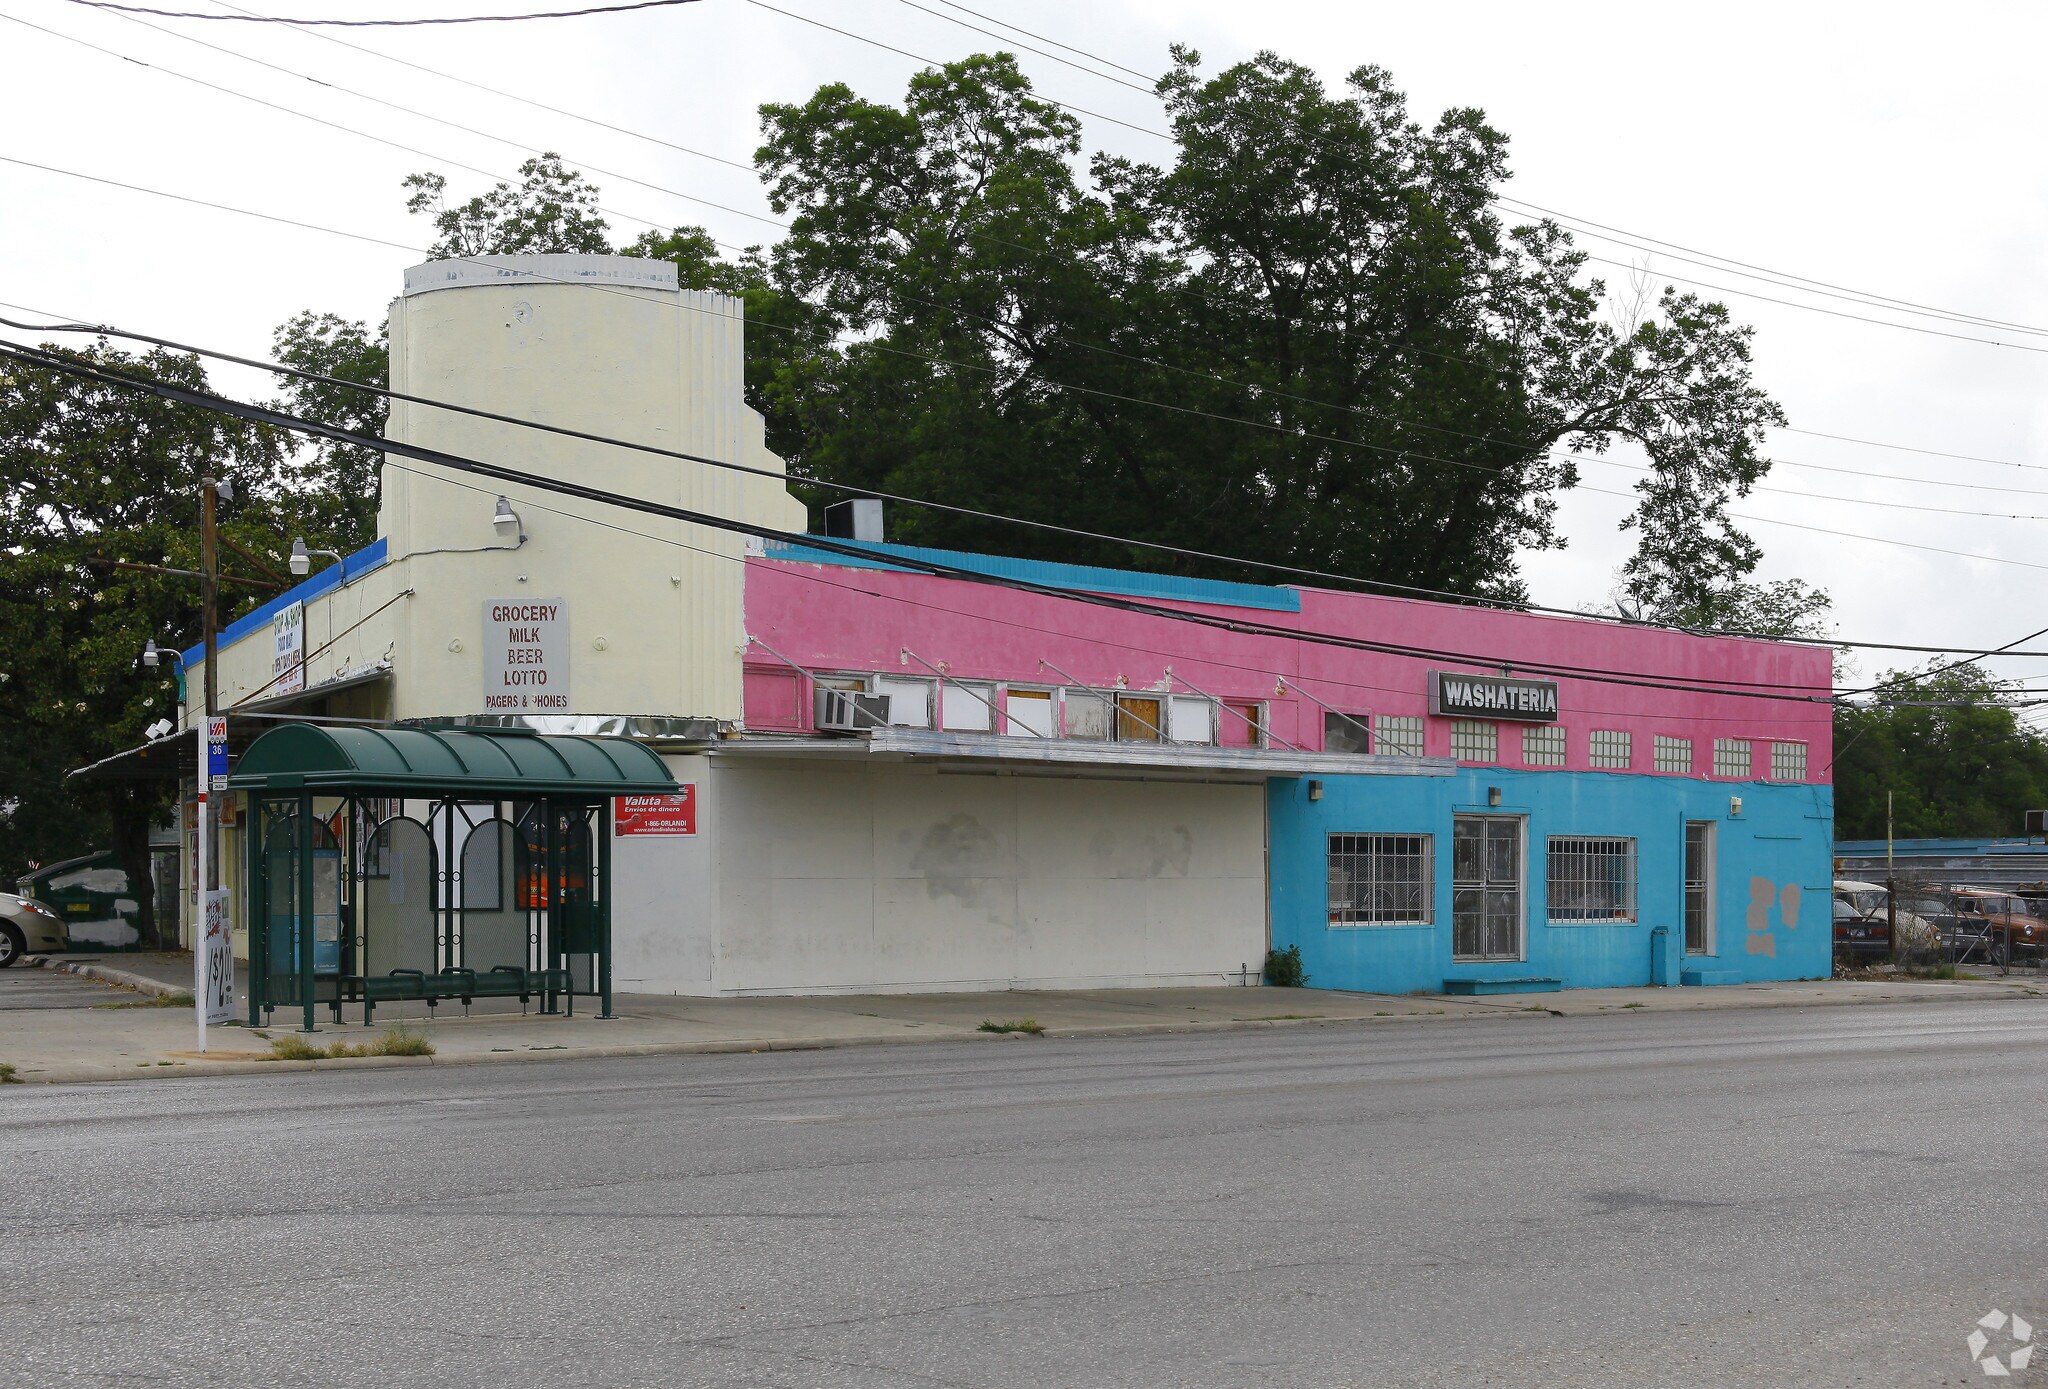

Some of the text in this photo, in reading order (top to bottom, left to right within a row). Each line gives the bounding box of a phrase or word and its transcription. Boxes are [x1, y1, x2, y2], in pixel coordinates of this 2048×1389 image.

[493, 606, 557, 622] GROCERY
[509, 628, 540, 642] MILK
[508, 649, 543, 664] BEER
[504, 670, 547, 685] LOTTO
[486, 695, 518, 708] PAGERS
[522, 696, 528, 707] &
[1444, 681, 1556, 712] WASHATERIA
[212, 745, 222, 755] 36
[625, 796, 662, 806] Valuta
